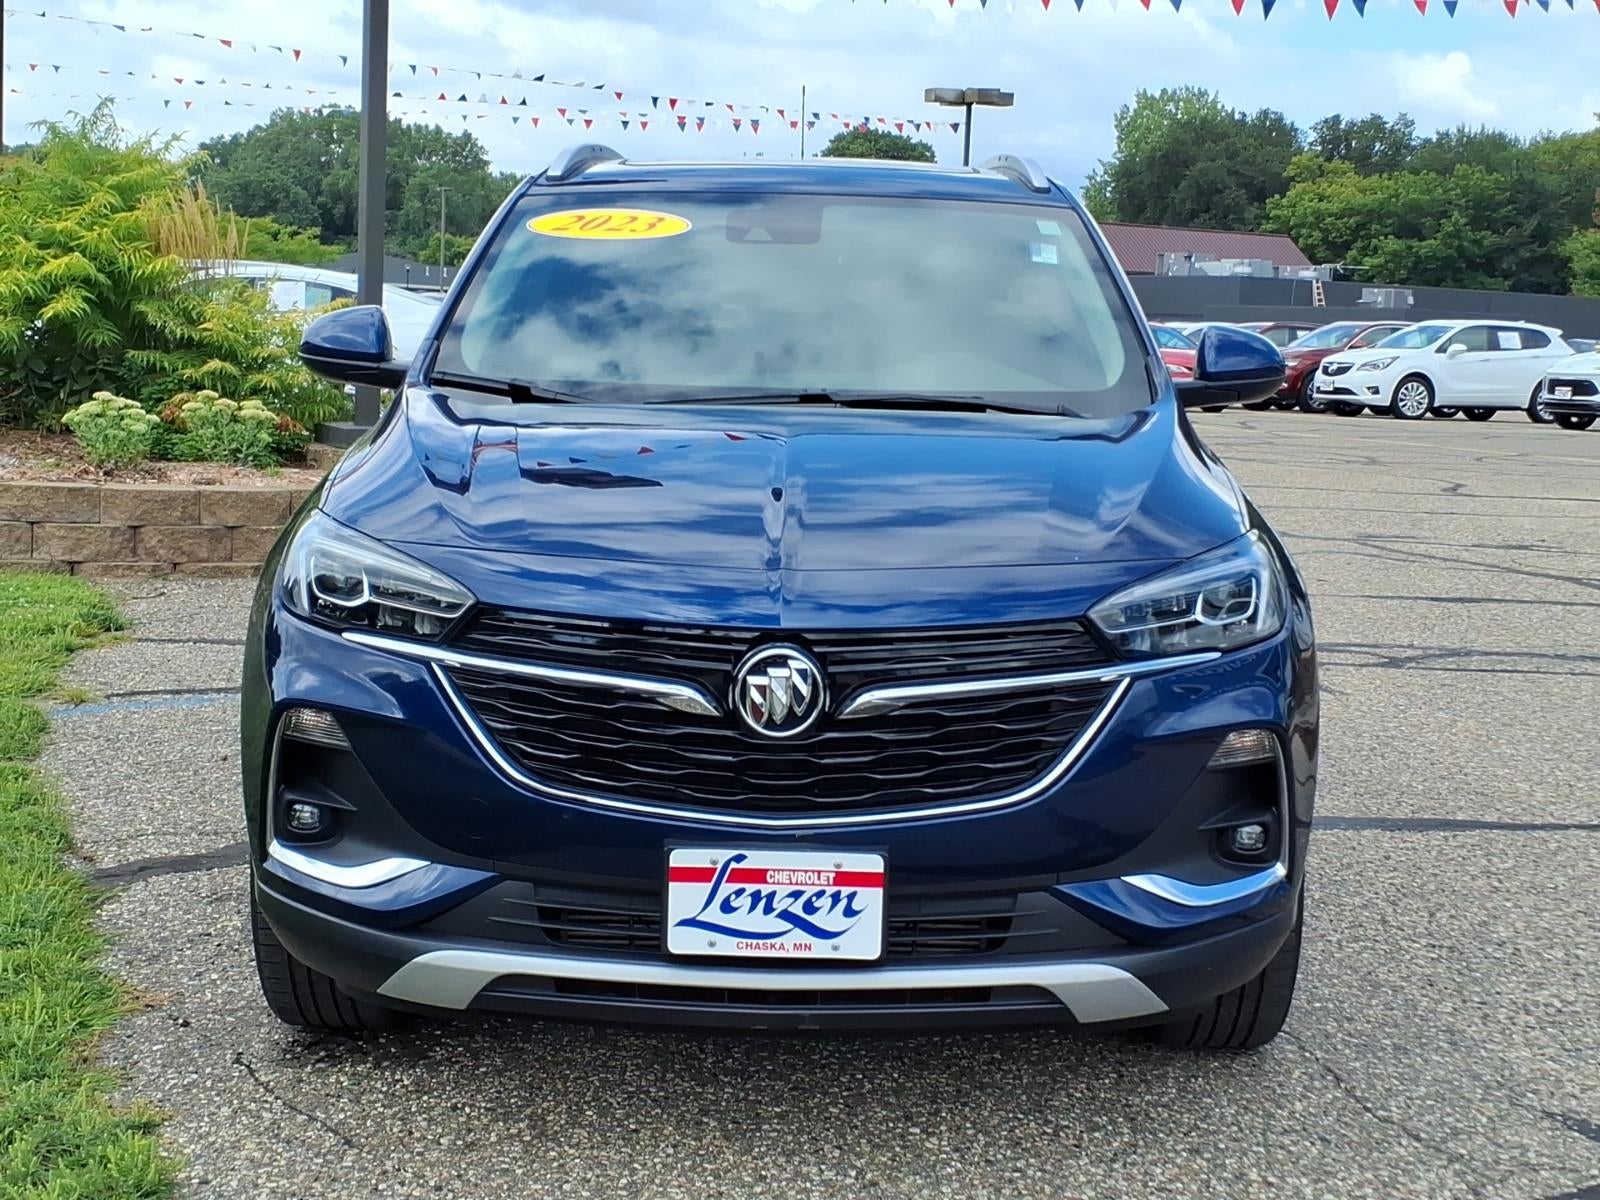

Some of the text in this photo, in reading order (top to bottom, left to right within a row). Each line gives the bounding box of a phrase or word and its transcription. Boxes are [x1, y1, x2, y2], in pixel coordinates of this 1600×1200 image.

[551, 215, 666, 232] 2023
[766, 870, 836, 886] CHEVROLET
[672, 853, 870, 940] Lenzen
[736, 941, 812, 953] CHASKA, MN
